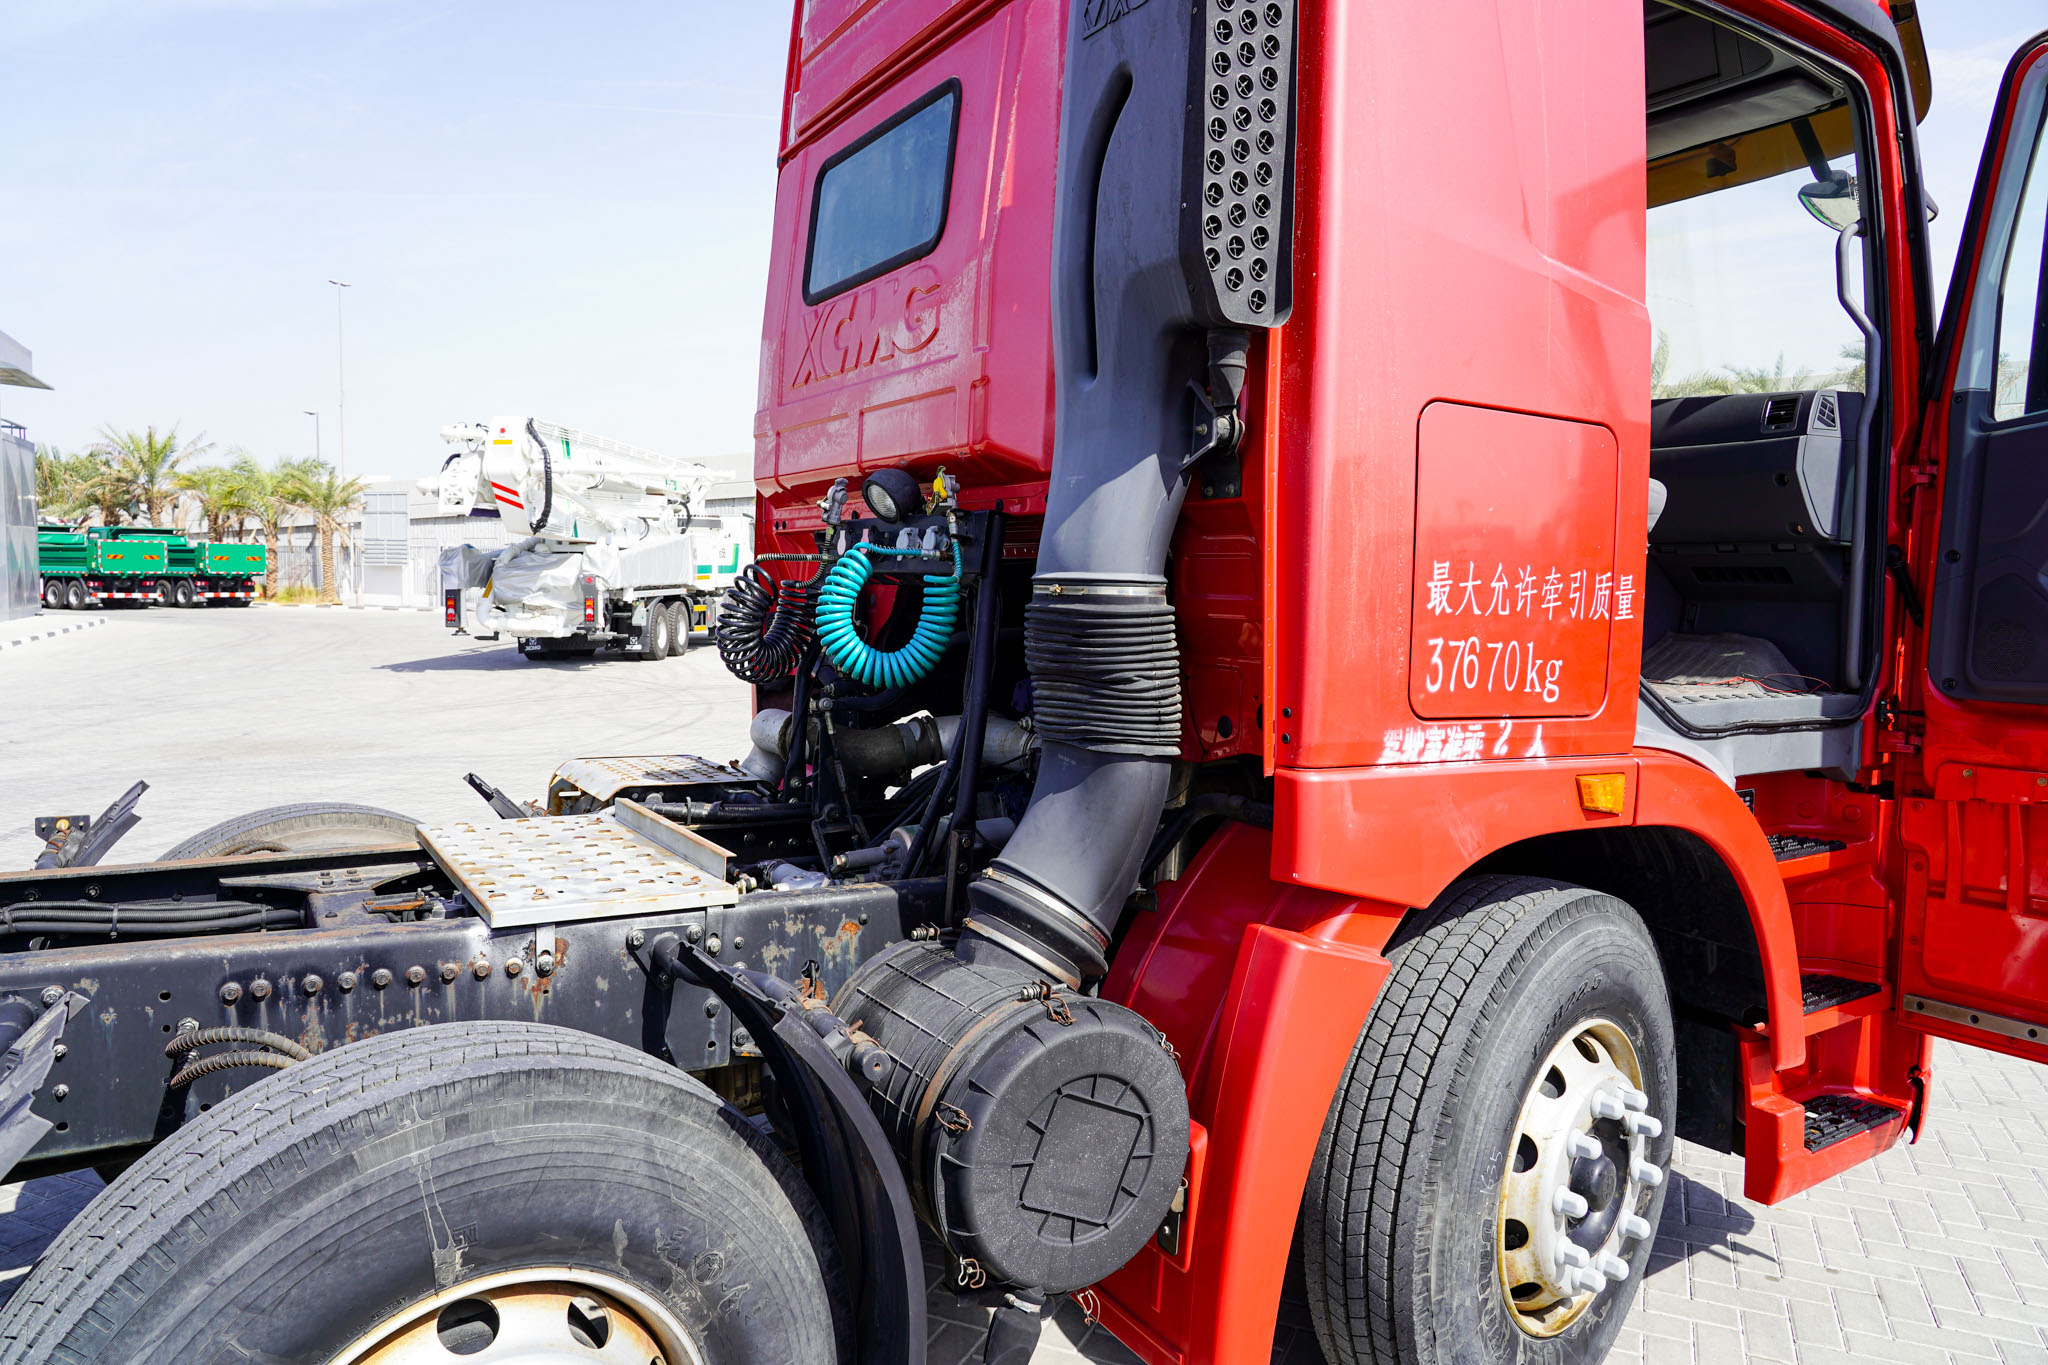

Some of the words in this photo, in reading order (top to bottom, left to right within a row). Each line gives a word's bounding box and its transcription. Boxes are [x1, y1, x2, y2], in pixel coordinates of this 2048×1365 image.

[791, 264, 942, 389] XCMG
[1426, 559, 1637, 621] 最大允许牵引质量
[1524, 724, 1547, 764] 人
